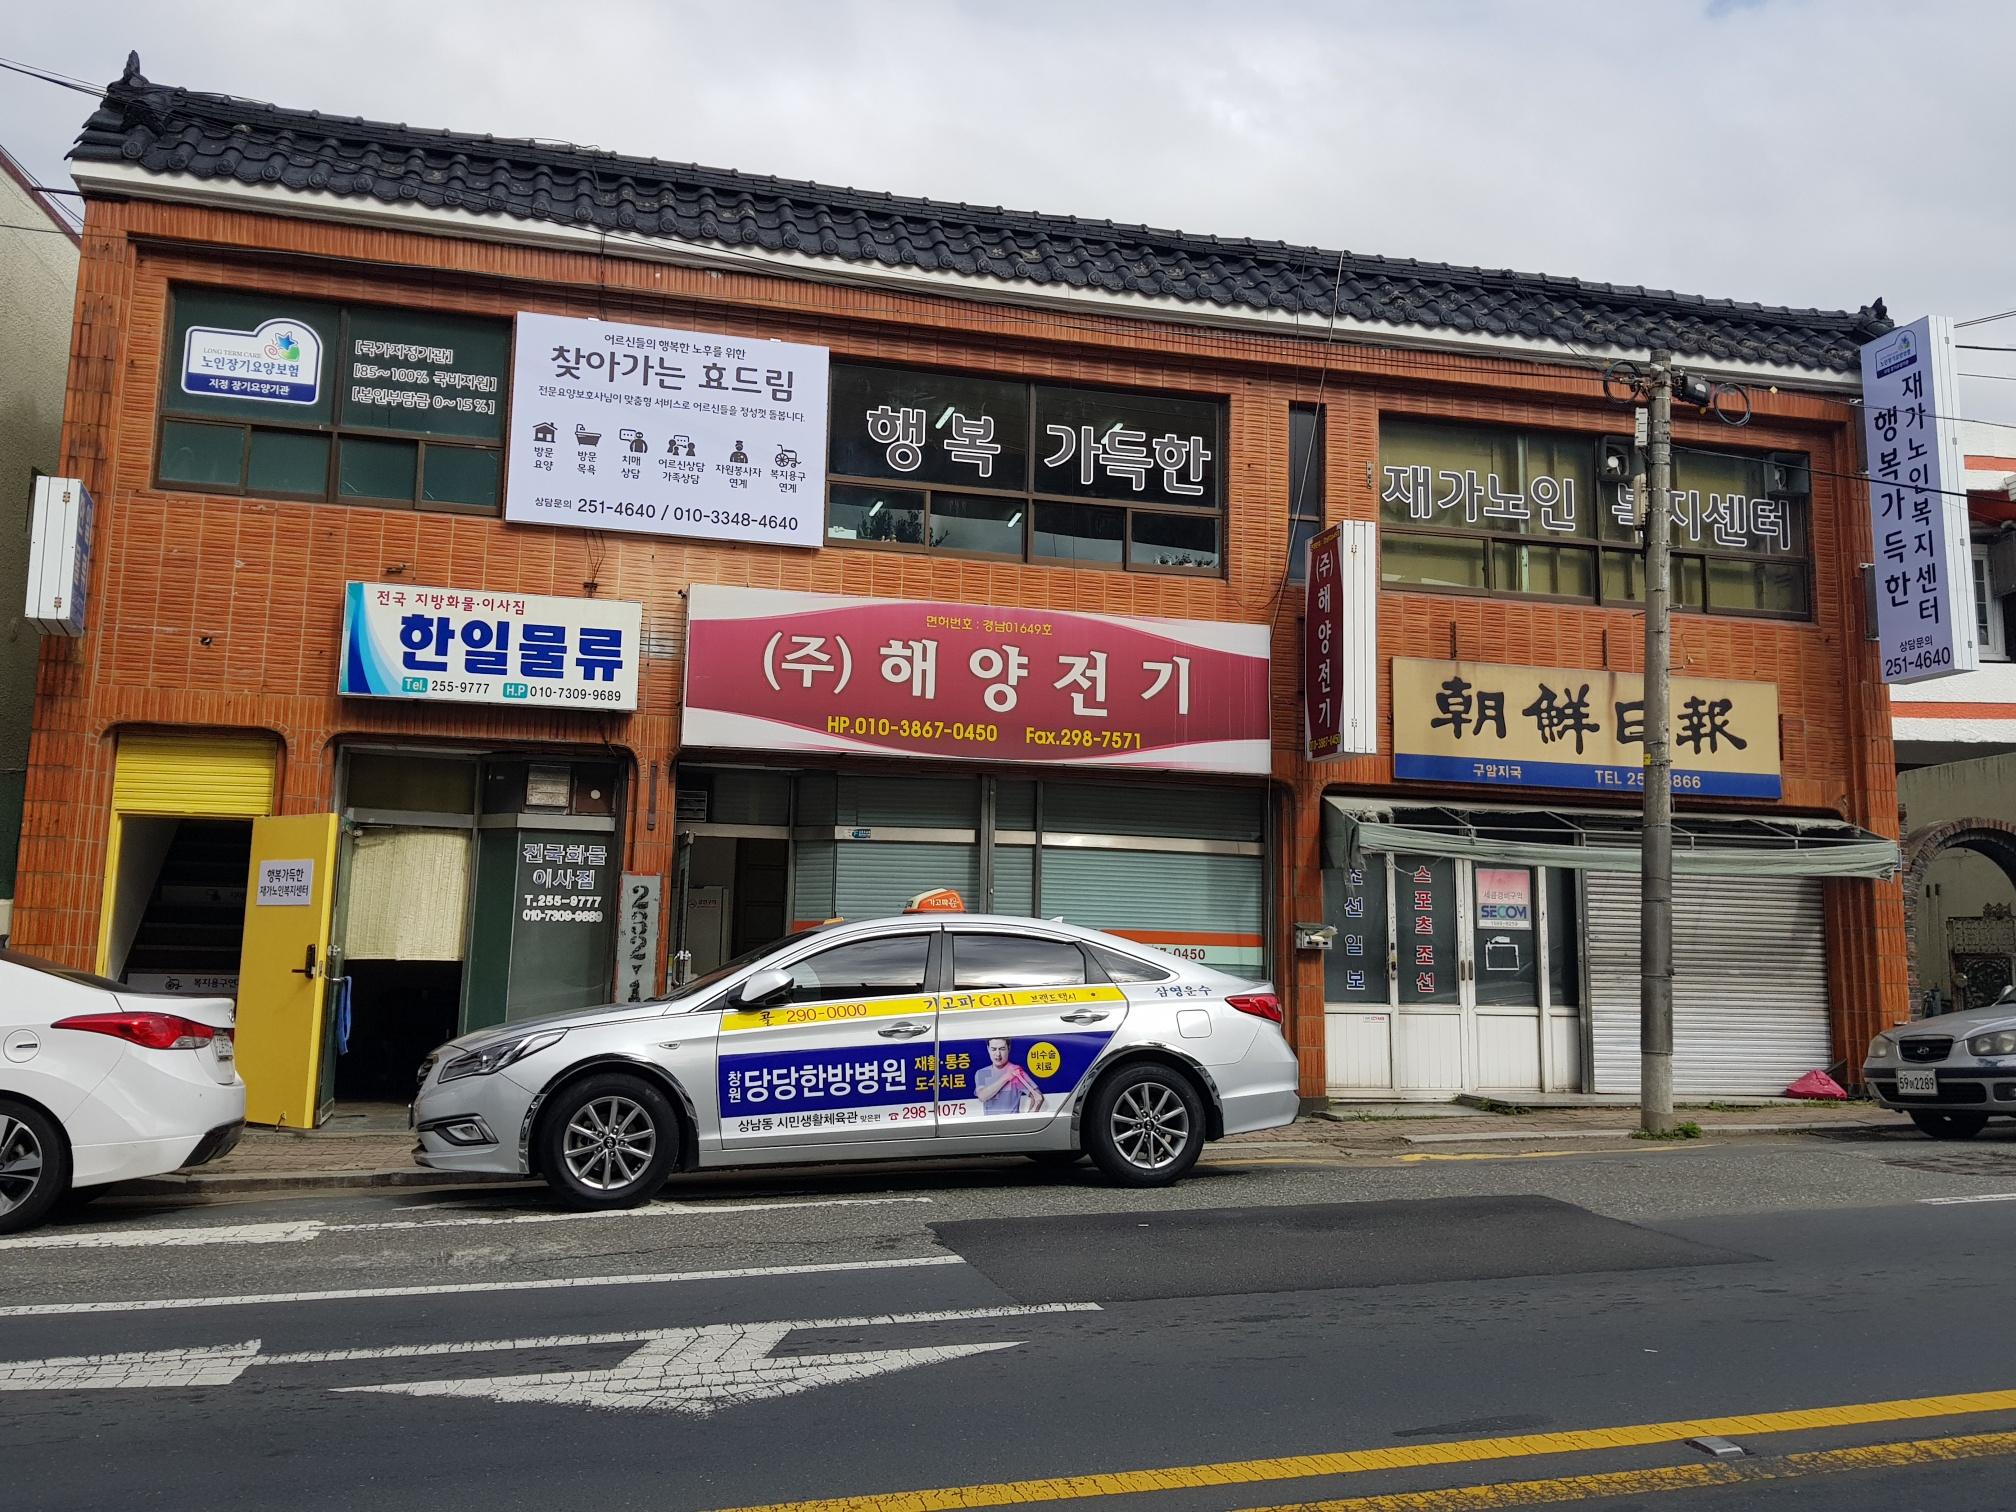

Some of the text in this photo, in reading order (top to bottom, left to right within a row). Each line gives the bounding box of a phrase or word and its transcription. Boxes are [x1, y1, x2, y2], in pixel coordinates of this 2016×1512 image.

[354, 340, 454, 364] [국가지정기관]
[604, 334, 747, 360] 어르신들의 행복한 노후를 위한
[201, 356, 299, 377] 노인장기요양보험
[551, 345, 794, 402] 찾아가는 효드림
[209, 378, 290, 395] 지정 장기요양기관
[353, 363, 498, 392] [85~100% 국비지원]
[351, 386, 431, 409] [본인부담금
[538, 385, 622, 404] 전문요양보호사님이
[624, 394, 652, 408] 맞춤형
[654, 398, 691, 410] 서비스로
[693, 402, 738, 416] 어르신들을
[740, 406, 767, 419] 정성껏
[534, 446, 554, 459] 방문
[577, 450, 597, 463] 방문
[622, 455, 641, 466] 치매
[866, 405, 1211, 496] 행복 가득한
[533, 460, 554, 471] 요양
[577, 463, 597, 475] 목욕
[621, 468, 640, 480] 상담
[658, 458, 706, 473] 어르신상담
[715, 464, 762, 477] 자원봉사자
[770, 469, 807, 482] 복지용구
[662, 471, 700, 485] 가족상담
[729, 478, 748, 489] 연계
[779, 482, 797, 493] 연계
[1382, 465, 1576, 532] 재가노인
[1873, 405, 1912, 609] 행복가득한
[1901, 370, 1940, 625] 재가노인복지센터
[535, 497, 799, 531] 상담문의 251-4640 / 010-3348-4640
[1315, 549, 1334, 582] (주)
[376, 590, 407, 608] 전국
[926, 615, 973, 630] 면허번호
[983, 619, 1053, 636] 경남01649호
[399, 613, 623, 682] 한일물류
[1899, 634, 1933, 653] 상담문의
[1317, 582, 1332, 729] 해양전기
[1885, 646, 1951, 677] 251-4640
[762, 631, 1192, 717] (주) 해양전기
[404, 677, 622, 702] Tel. 255-9777 H.P 010-7309-9689
[1430, 676, 1747, 755] 朝鮮日報
[827, 714, 1142, 750] HP.010-3867-0450 Fax.298-7571
[1472, 763, 1522, 780] 구암지국
[1594, 769, 1622, 785] TEL
[267, 868, 305, 884] 행복가득한
[532, 868, 596, 890] 이사짐
[259, 884, 309, 897] 재가노인복지센터
[524, 894, 602, 908] T.255-9777
[1480, 905, 1527, 919] SECOM
[1413, 865, 1435, 993] 스포츠조선
[923, 994, 976, 1010] 가고파
[978, 993, 1016, 1008] Call
[1155, 984, 1213, 998] 삼영운수
[759, 1004, 867, 1027] 콜 290-0000
[1030, 1049, 1056, 1060] 비수술
[1035, 1061, 1053, 1072] 치료
[727, 1070, 742, 1104] 창원
[744, 1058, 907, 1103] 당당한방병원
[915, 1074, 967, 1091] 도수치료
[738, 1103, 967, 1133] 상남동 시민생활체육관 맞은편 298-1075
